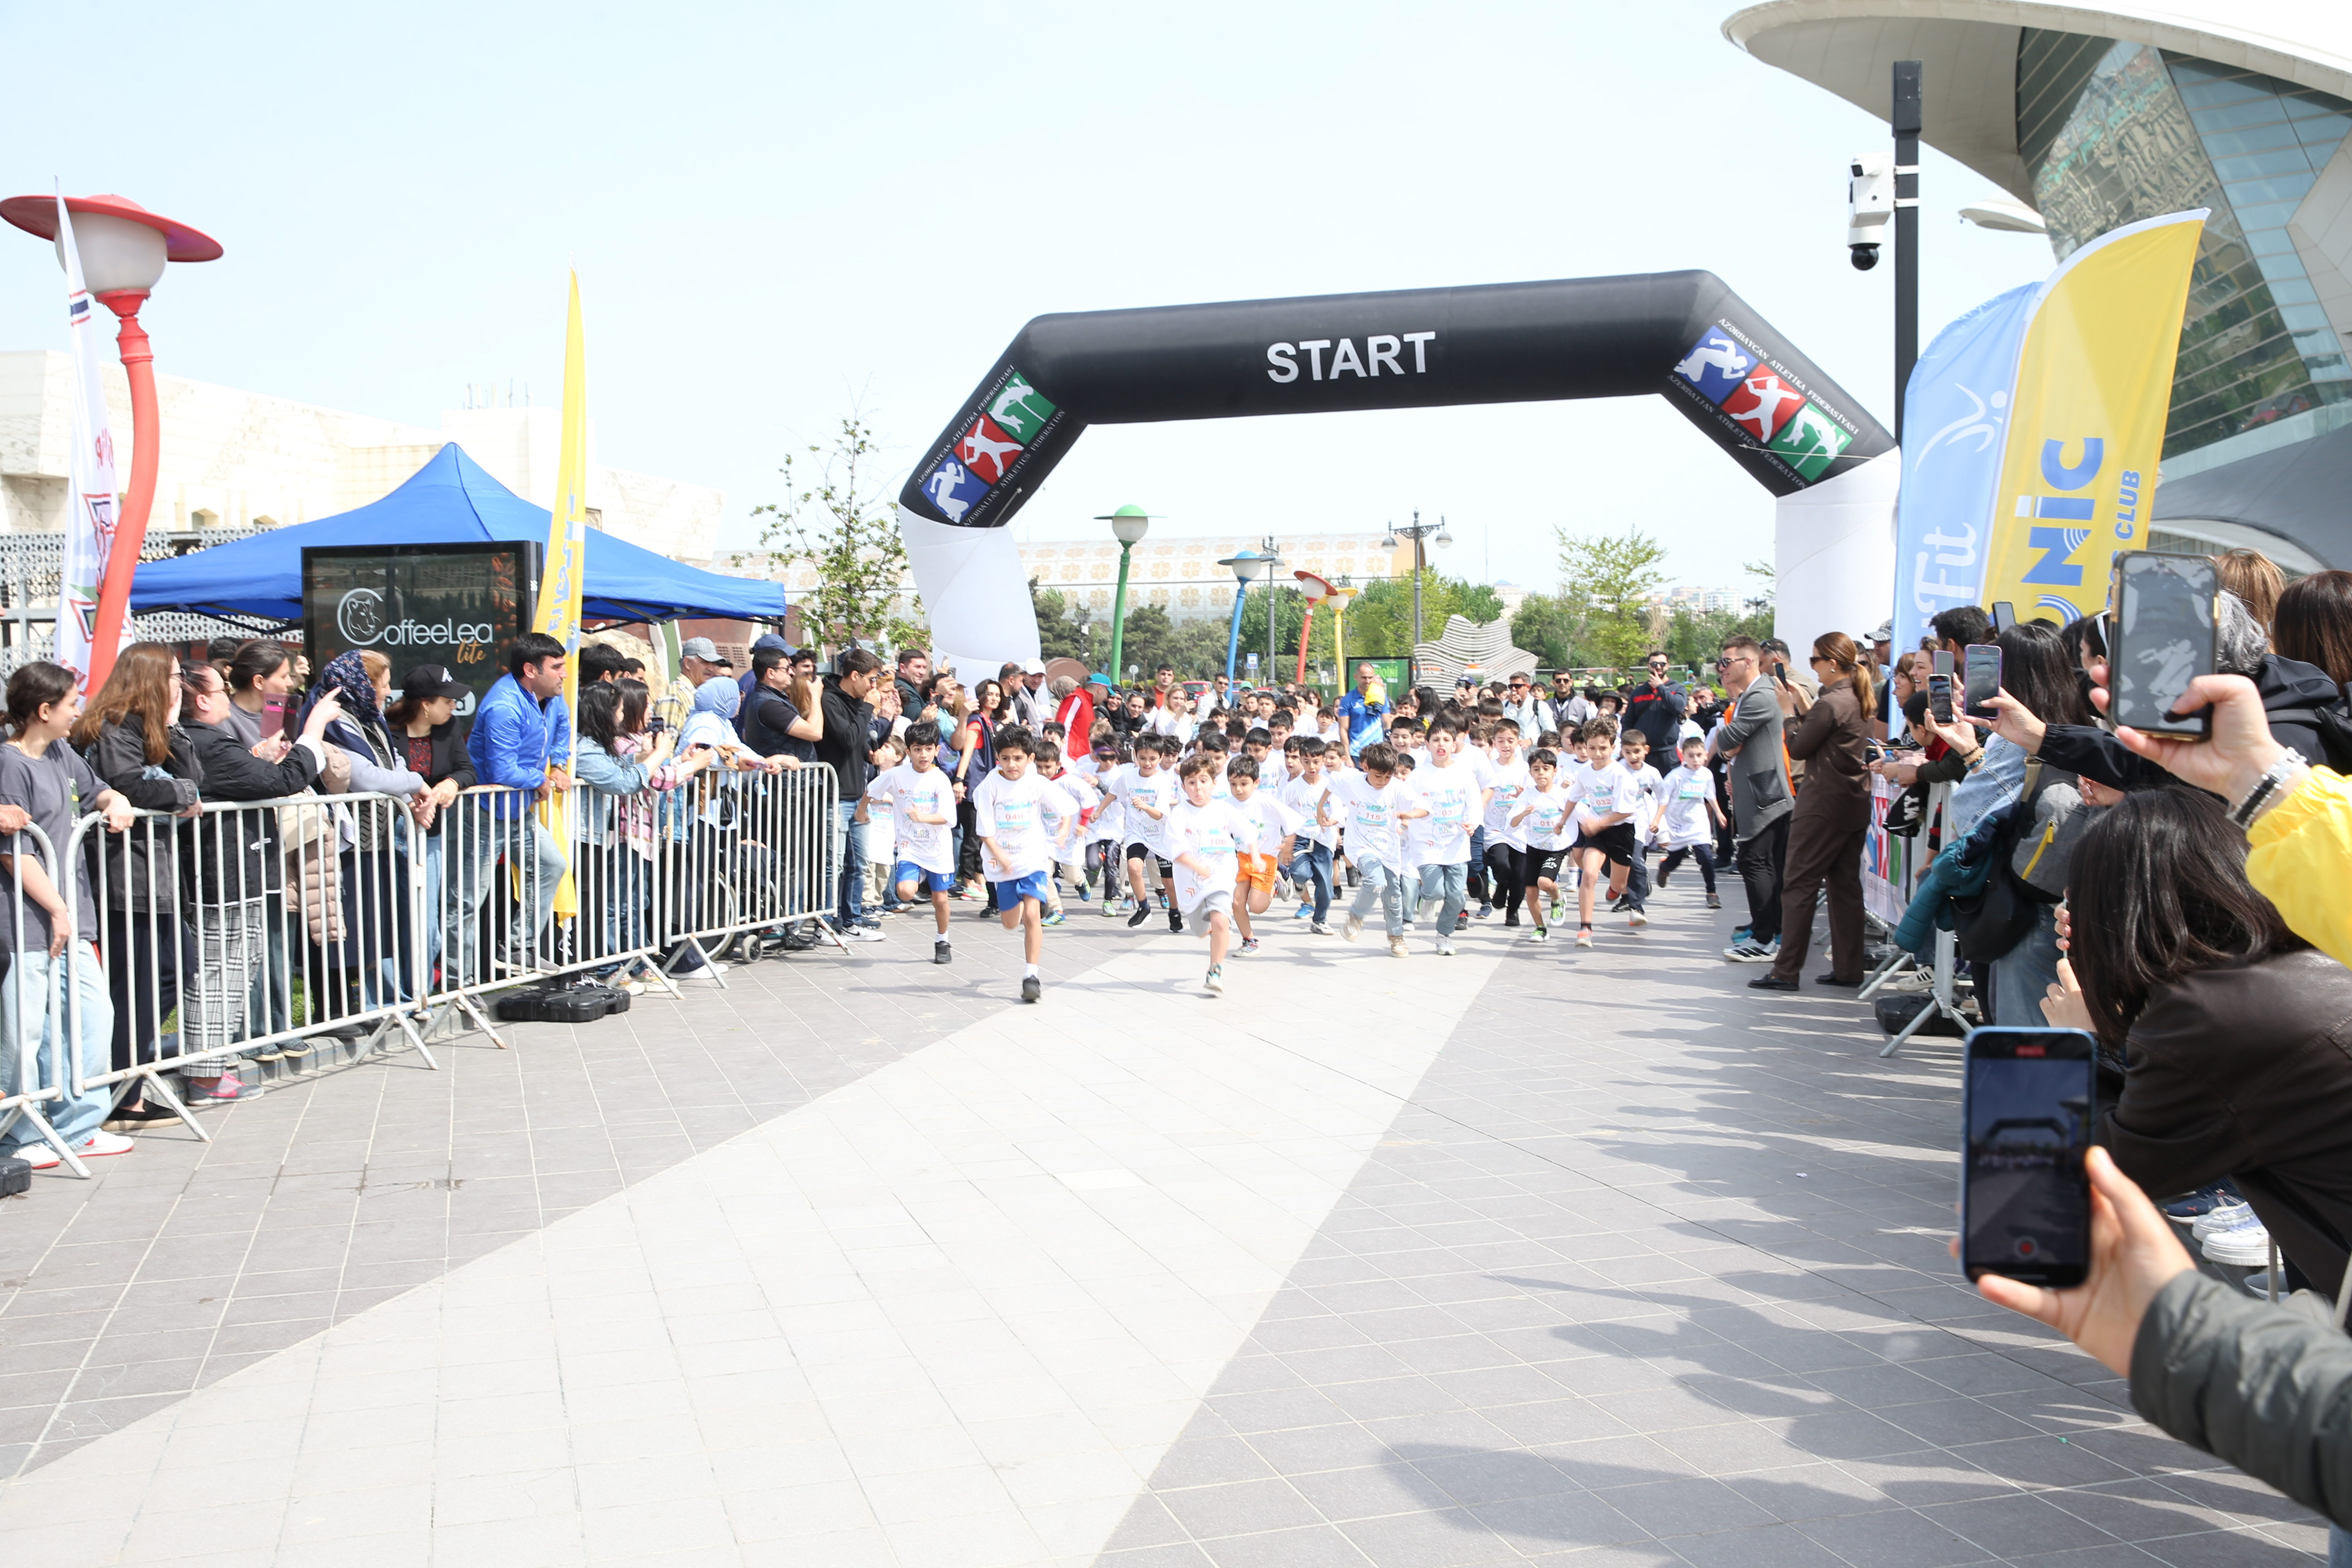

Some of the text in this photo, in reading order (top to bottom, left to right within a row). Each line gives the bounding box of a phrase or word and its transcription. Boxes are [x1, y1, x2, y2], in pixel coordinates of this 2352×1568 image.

[1267, 331, 1436, 383] START
[1718, 318, 1859, 435] AZƏRBAYCAN ATLETİKA FEDERASİYASI
[1000, 452, 1031, 489] ATHLETICS
[1030, 409, 1066, 452] FEDERATION
[1667, 374, 1808, 490] AZERBAIJAN ATHLETICS FEDERATION
[2114, 470, 2141, 540] CLUB
[337, 587, 493, 646] CoffeeLea
[457, 637, 487, 665] lite
[1365, 812, 1381, 820] 115
